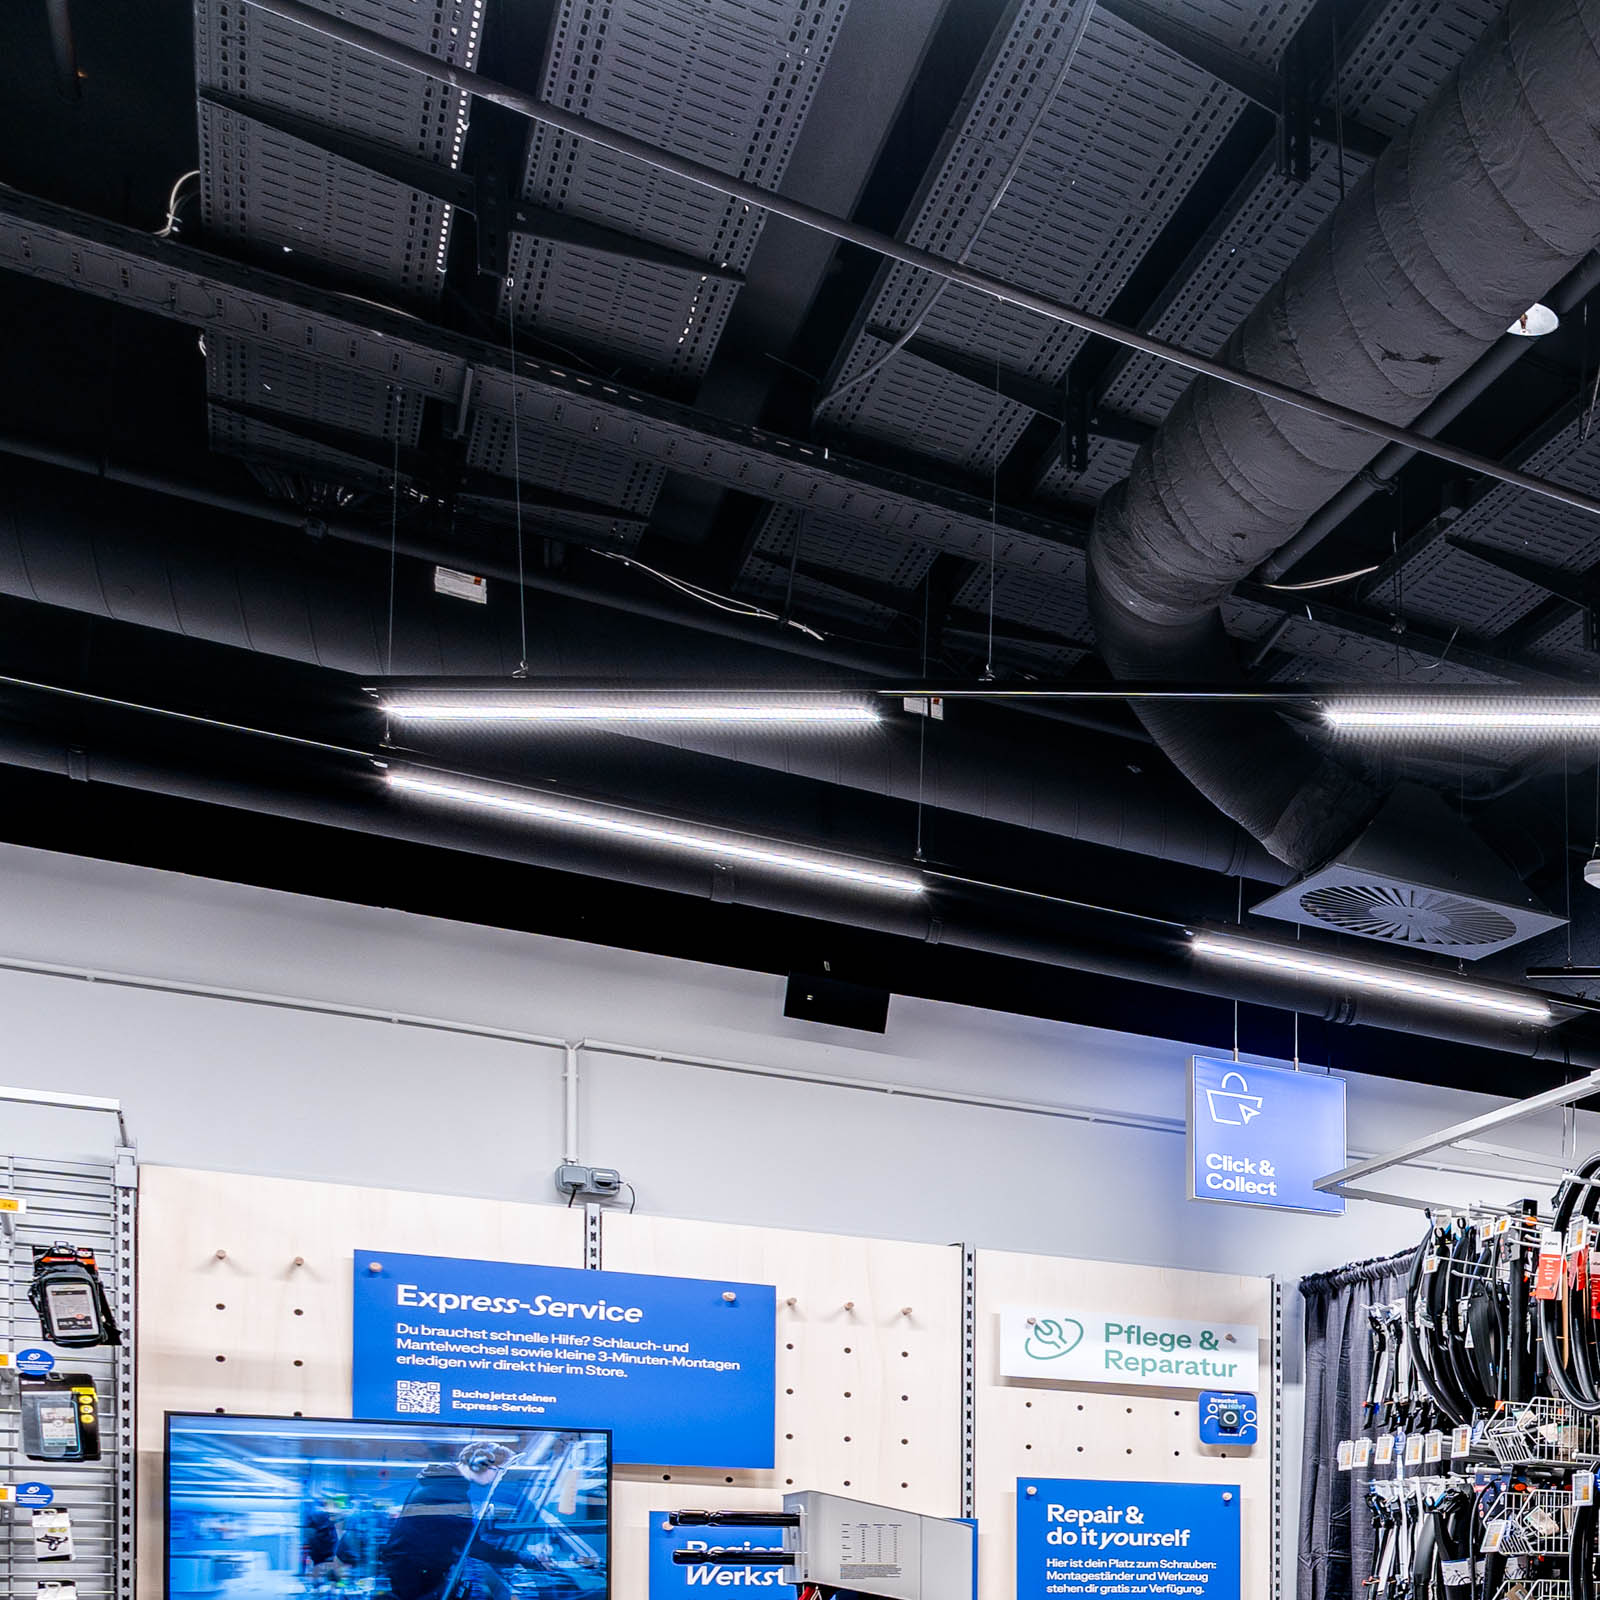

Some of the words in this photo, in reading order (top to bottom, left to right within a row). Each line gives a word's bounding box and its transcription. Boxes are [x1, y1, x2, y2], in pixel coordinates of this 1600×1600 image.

[1206, 1153, 1256, 1186] Click
[1259, 1160, 1275, 1176] &
[1206, 1173, 1277, 1196] Collect
[397, 1284, 643, 1323] Express-Service
[397, 1323, 419, 1335] Du
[421, 1324, 488, 1338] brauchst
[490, 1330, 549, 1344] schnelle
[551, 1333, 591, 1346] Hilfe?
[592, 1336, 661, 1351] Schlauch-
[663, 1343, 689, 1353] und
[1105, 1323, 1192, 1353] Pflege
[1199, 1330, 1219, 1351] &
[396, 1354, 467, 1369] erledigen
[468, 1359, 492, 1369] wir
[493, 1359, 536, 1372] direkt
[537, 1362, 565, 1373] hier
[566, 1364, 584, 1375] im
[585, 1365, 628, 1377] Store.
[397, 1338, 509, 1355] Mantelwechsel
[511, 1348, 553, 1358] sowie
[555, 1348, 596, 1361] kleine
[598, 1351, 740, 1371] 3-Minuten-Montagen
[1105, 1349, 1238, 1378] Reparatur
[452, 1389, 490, 1401] Buche
[489, 1391, 517, 1401] jetzt
[518, 1393, 557, 1403] deinen
[452, 1400, 545, 1413] Express-Service
[1047, 1504, 1123, 1526] Repair
[1125, 1506, 1144, 1524] &
[1046, 1527, 1078, 1545] do
[1081, 1527, 1098, 1545] it
[1098, 1529, 1190, 1549] yourself
[1046, 1558, 1069, 1567] Hier
[1070, 1558, 1083, 1568] ist
[1084, 1559, 1107, 1568] dein
[1109, 1559, 1135, 1568] Platz
[1160, 1559, 1216, 1569] Schrauben:
[686, 1565, 786, 1586] Werkst
[1046, 1571, 1135, 1582] Montageständer
[1136, 1572, 1157, 1581] und
[1157, 1572, 1208, 1583] Werkzeug
[1046, 1584, 1084, 1593] stehen
[1084, 1584, 1099, 1593] dir
[1100, 1584, 1130, 1595] gratis
[1148, 1584, 1205, 1595] Verfügung.
